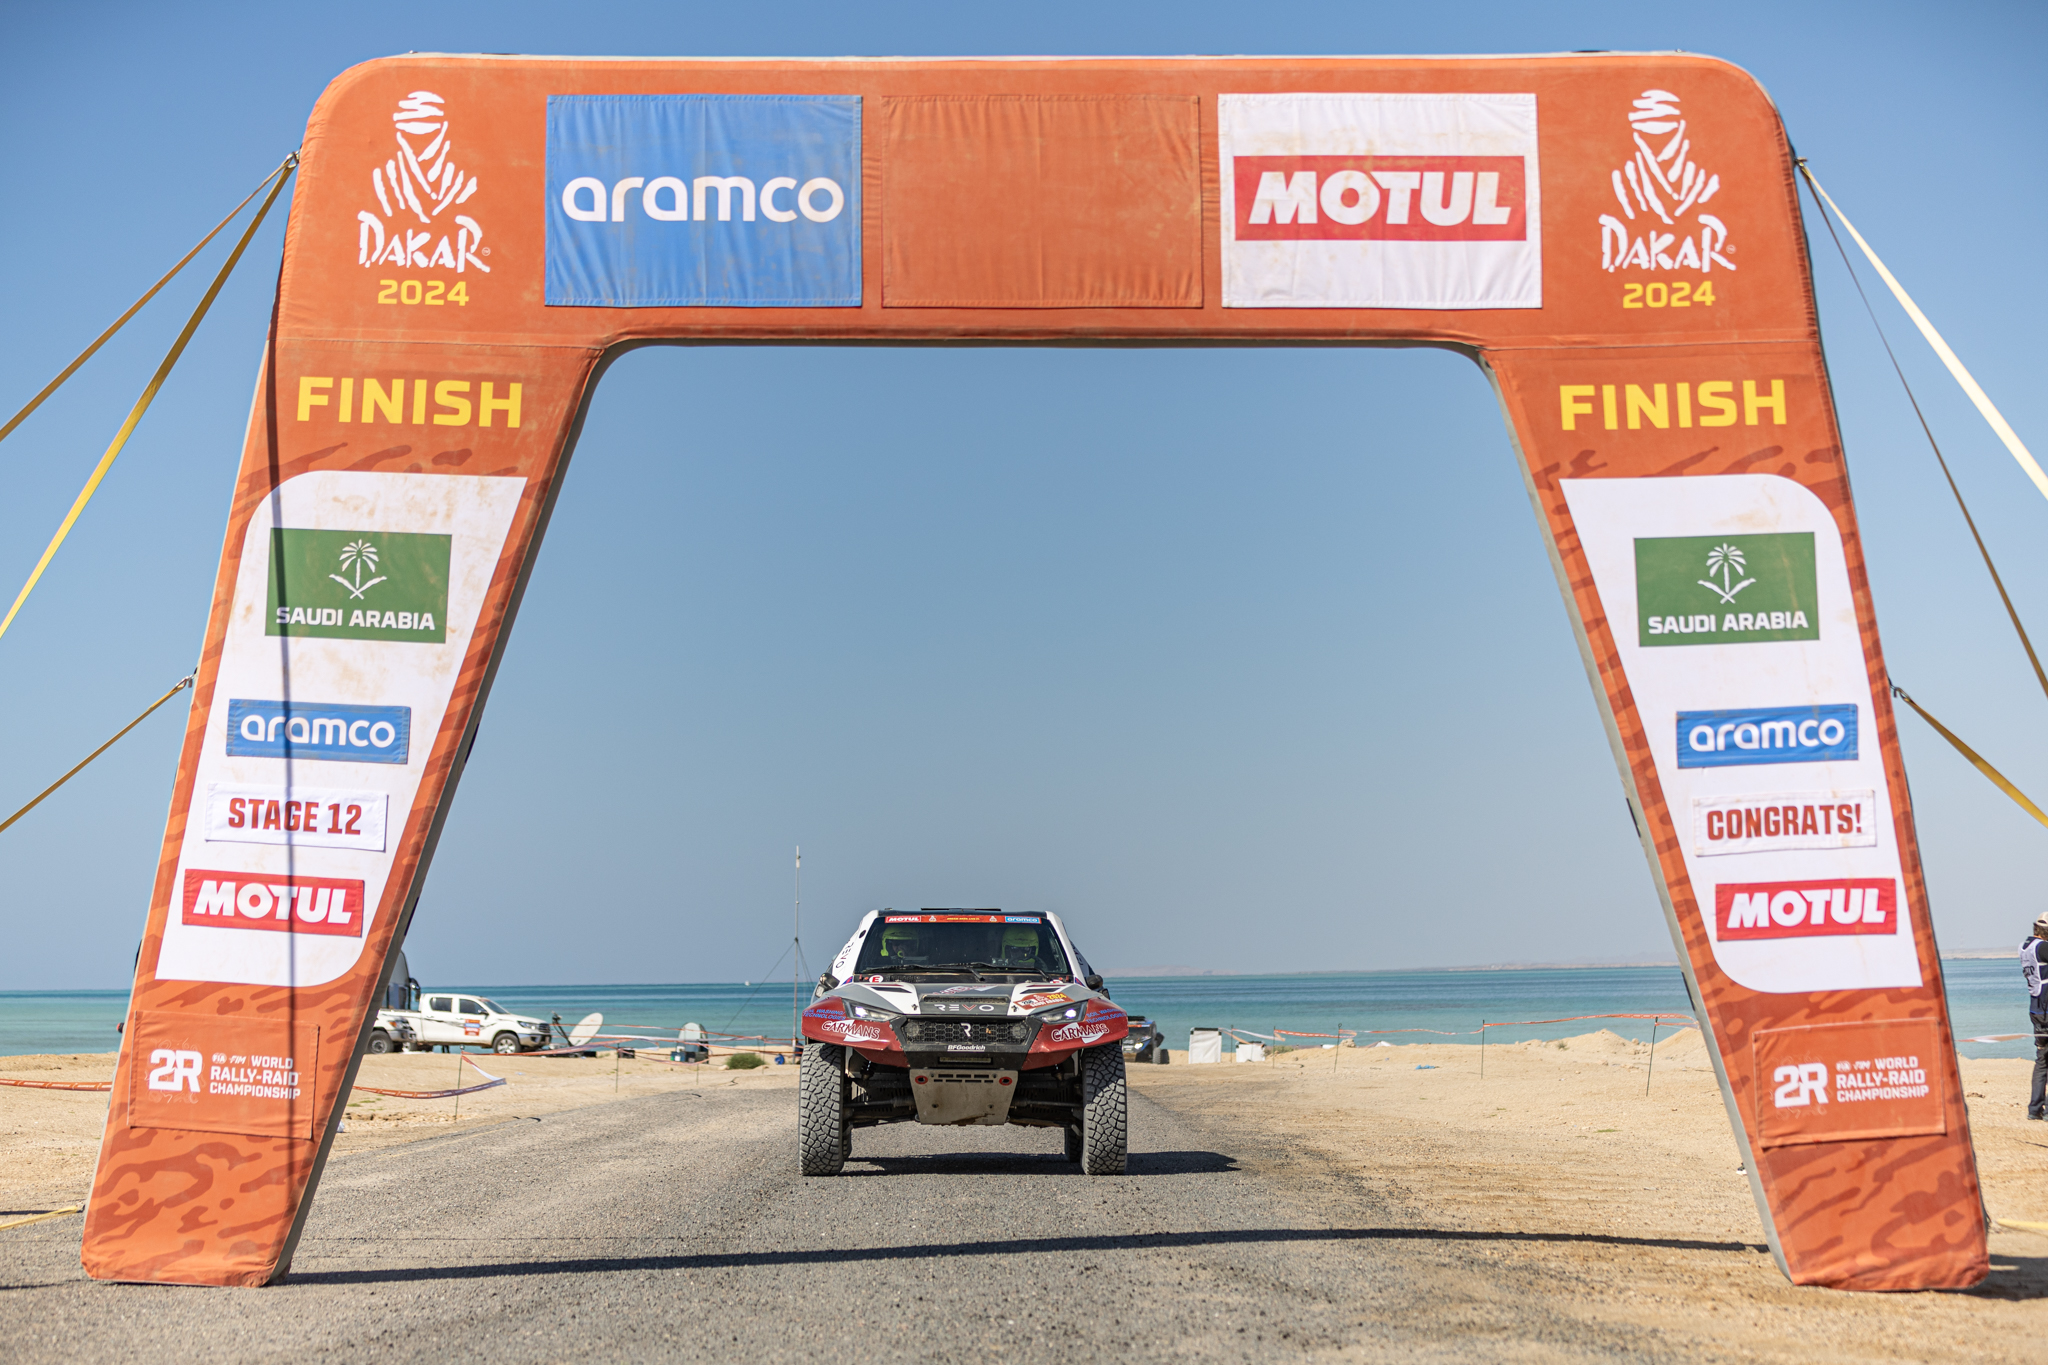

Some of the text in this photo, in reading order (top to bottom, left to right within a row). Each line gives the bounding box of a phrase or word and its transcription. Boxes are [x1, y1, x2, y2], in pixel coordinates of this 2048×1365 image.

[562, 175, 844, 223] aramco
[1248, 169, 1512, 226] MOTUL
[357, 210, 490, 273] DAKAR
[1598, 213, 1736, 273] DAKAR
[378, 279, 469, 306] 2024
[1622, 280, 1716, 308] 2024
[297, 376, 522, 428] FINISH
[1559, 379, 1787, 430] FINISH
[276, 607, 435, 630] SAUDI ARABIA
[1648, 611, 1809, 634] SAUDI ARABIA
[240, 714, 396, 748] aramco
[1688, 718, 1845, 752] aramco
[228, 797, 362, 835] STAGE 12
[1707, 803, 1862, 841] CONGRATS!
[192, 879, 352, 925] MOTUL
[1726, 888, 1886, 929] MOTUL
[934, 1003, 994, 1012] REVO
[251, 1055, 293, 1070] WORLD
[947, 1044, 986, 1052] BFGoodrich
[1874, 1056, 1918, 1070] WORLD
[149, 1049, 203, 1092] 2R
[210, 1066, 299, 1086] RALLY-RAID
[1773, 1062, 1829, 1108] 2R
[1836, 1069, 1926, 1089] RALLY-RAID
[209, 1082, 301, 1100] CHAMPIONSHIP
[1837, 1084, 1929, 1103] CHAMPIONSHIP
